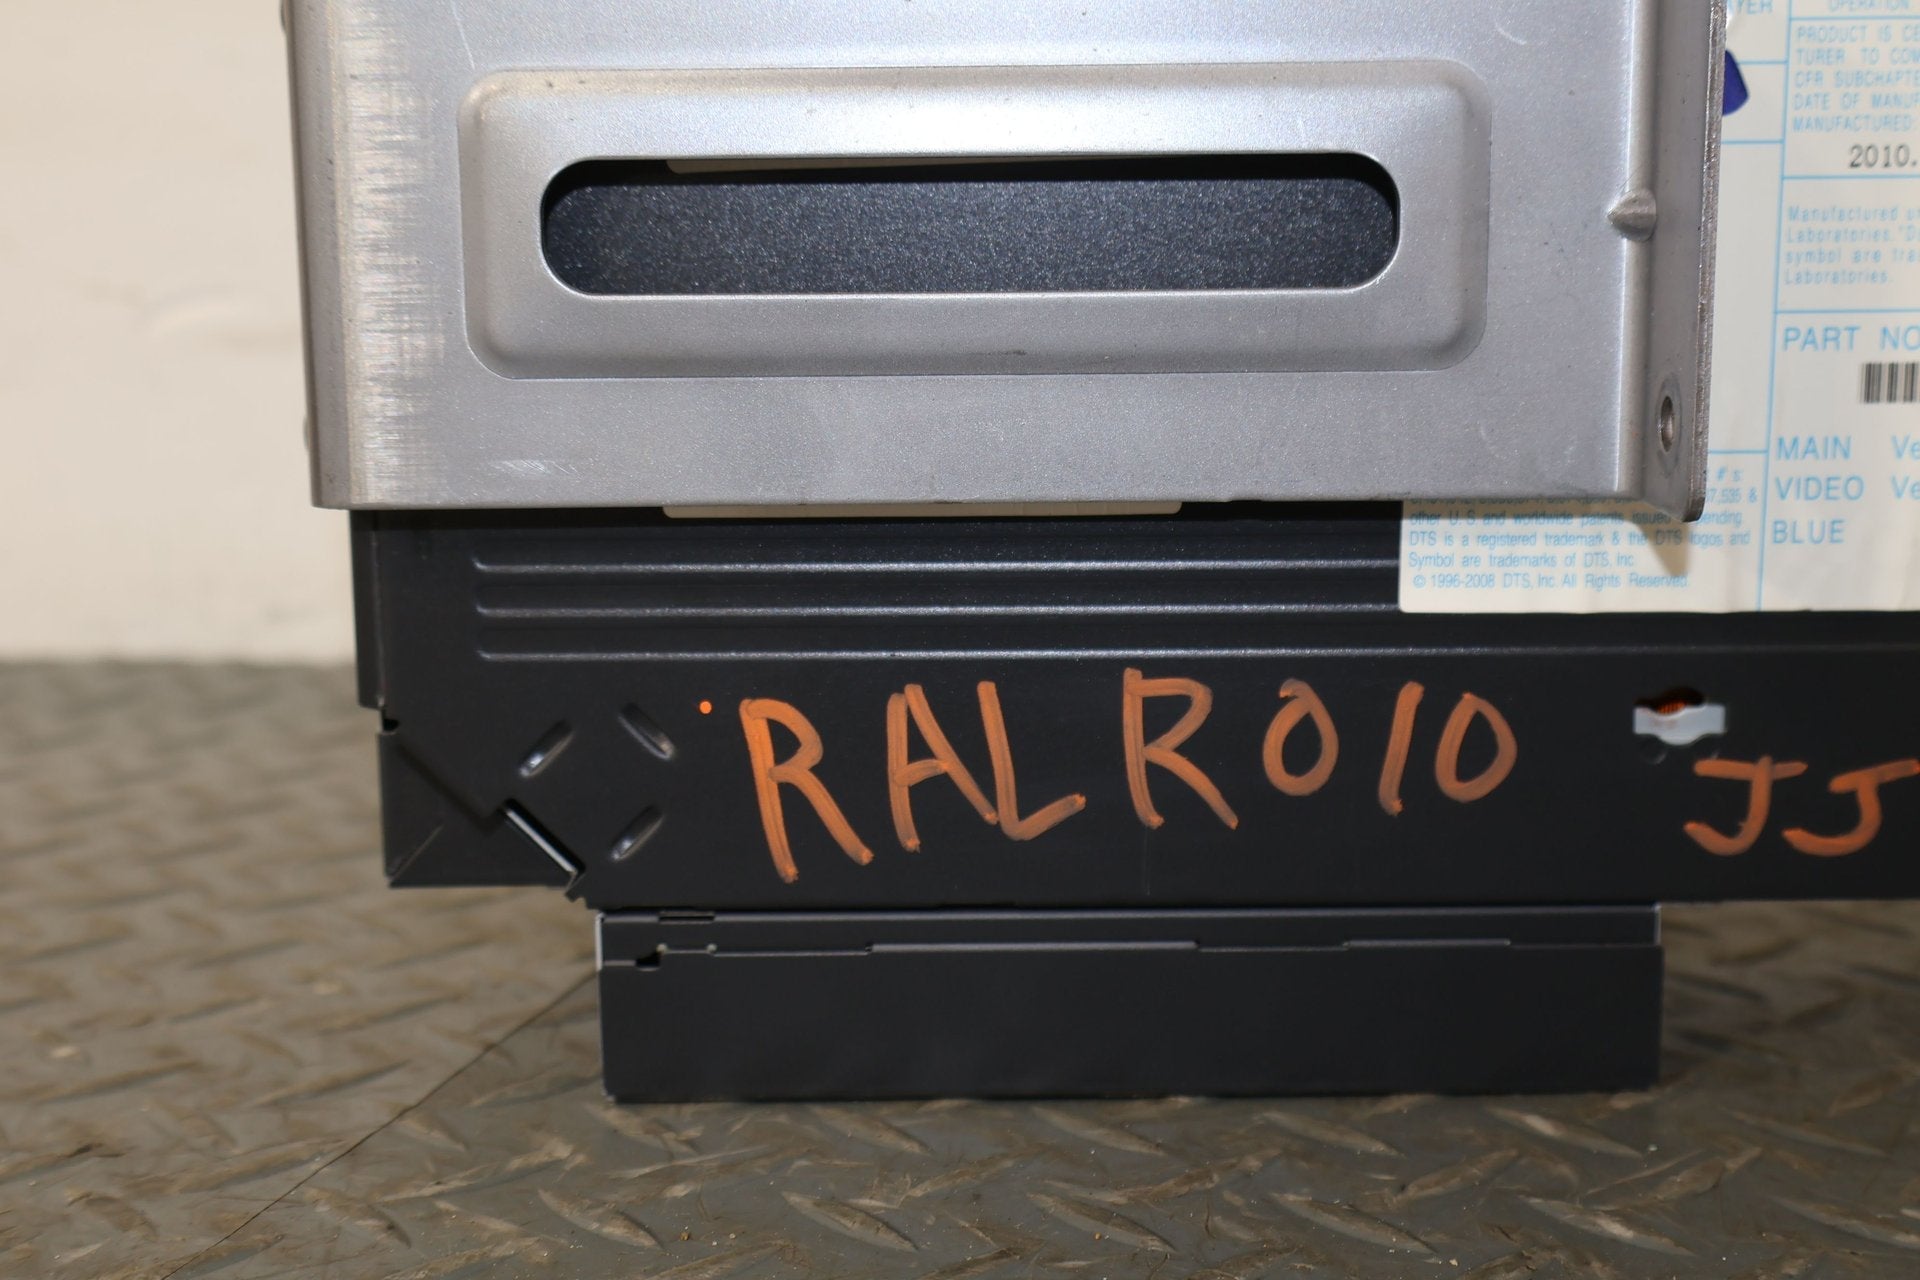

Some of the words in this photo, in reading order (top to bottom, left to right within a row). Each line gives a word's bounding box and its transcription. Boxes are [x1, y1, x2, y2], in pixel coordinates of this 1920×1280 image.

[1797, 25, 1868, 43] PRODUCT
[1861, 48, 1880, 65] TO
[1793, 92, 1830, 110] DATE
[1840, 92, 1859, 110] OF
[1788, 205, 1899, 222] Manufactured
[1785, 249, 1841, 265] symbol
[1852, 250, 1882, 264] are
[1782, 326, 1860, 351] PART
[1776, 435, 1852, 461] MAIN
[1775, 476, 1865, 501] VIDEO
[1410, 510, 1441, 526] other
[1483, 510, 1505, 526] and
[1514, 510, 1573, 526] worldwide
[1581, 511, 1624, 527] patents
[1700, 510, 1742, 528] ending
[1410, 531, 1436, 546] DTS
[1445, 532, 1454, 546] is
[1462, 535, 1469, 546] a
[1477, 532, 1537, 549] registered
[1545, 531, 1604, 546] trademark
[1611, 531, 1619, 546] &
[1628, 531, 1647, 545] the
[1655, 529, 1682, 545] DTS
[1730, 530, 1751, 546] and
[1772, 519, 1845, 545] BLUE
[1408, 552, 1455, 570] Symbol
[1462, 554, 1482, 568] are
[1489, 552, 1557, 568] trademarks
[1564, 552, 1577, 567] of
[1431, 573, 1496, 589] 1996-2008
[1562, 573, 1577, 588] All
[1584, 573, 1621, 592] Rights
